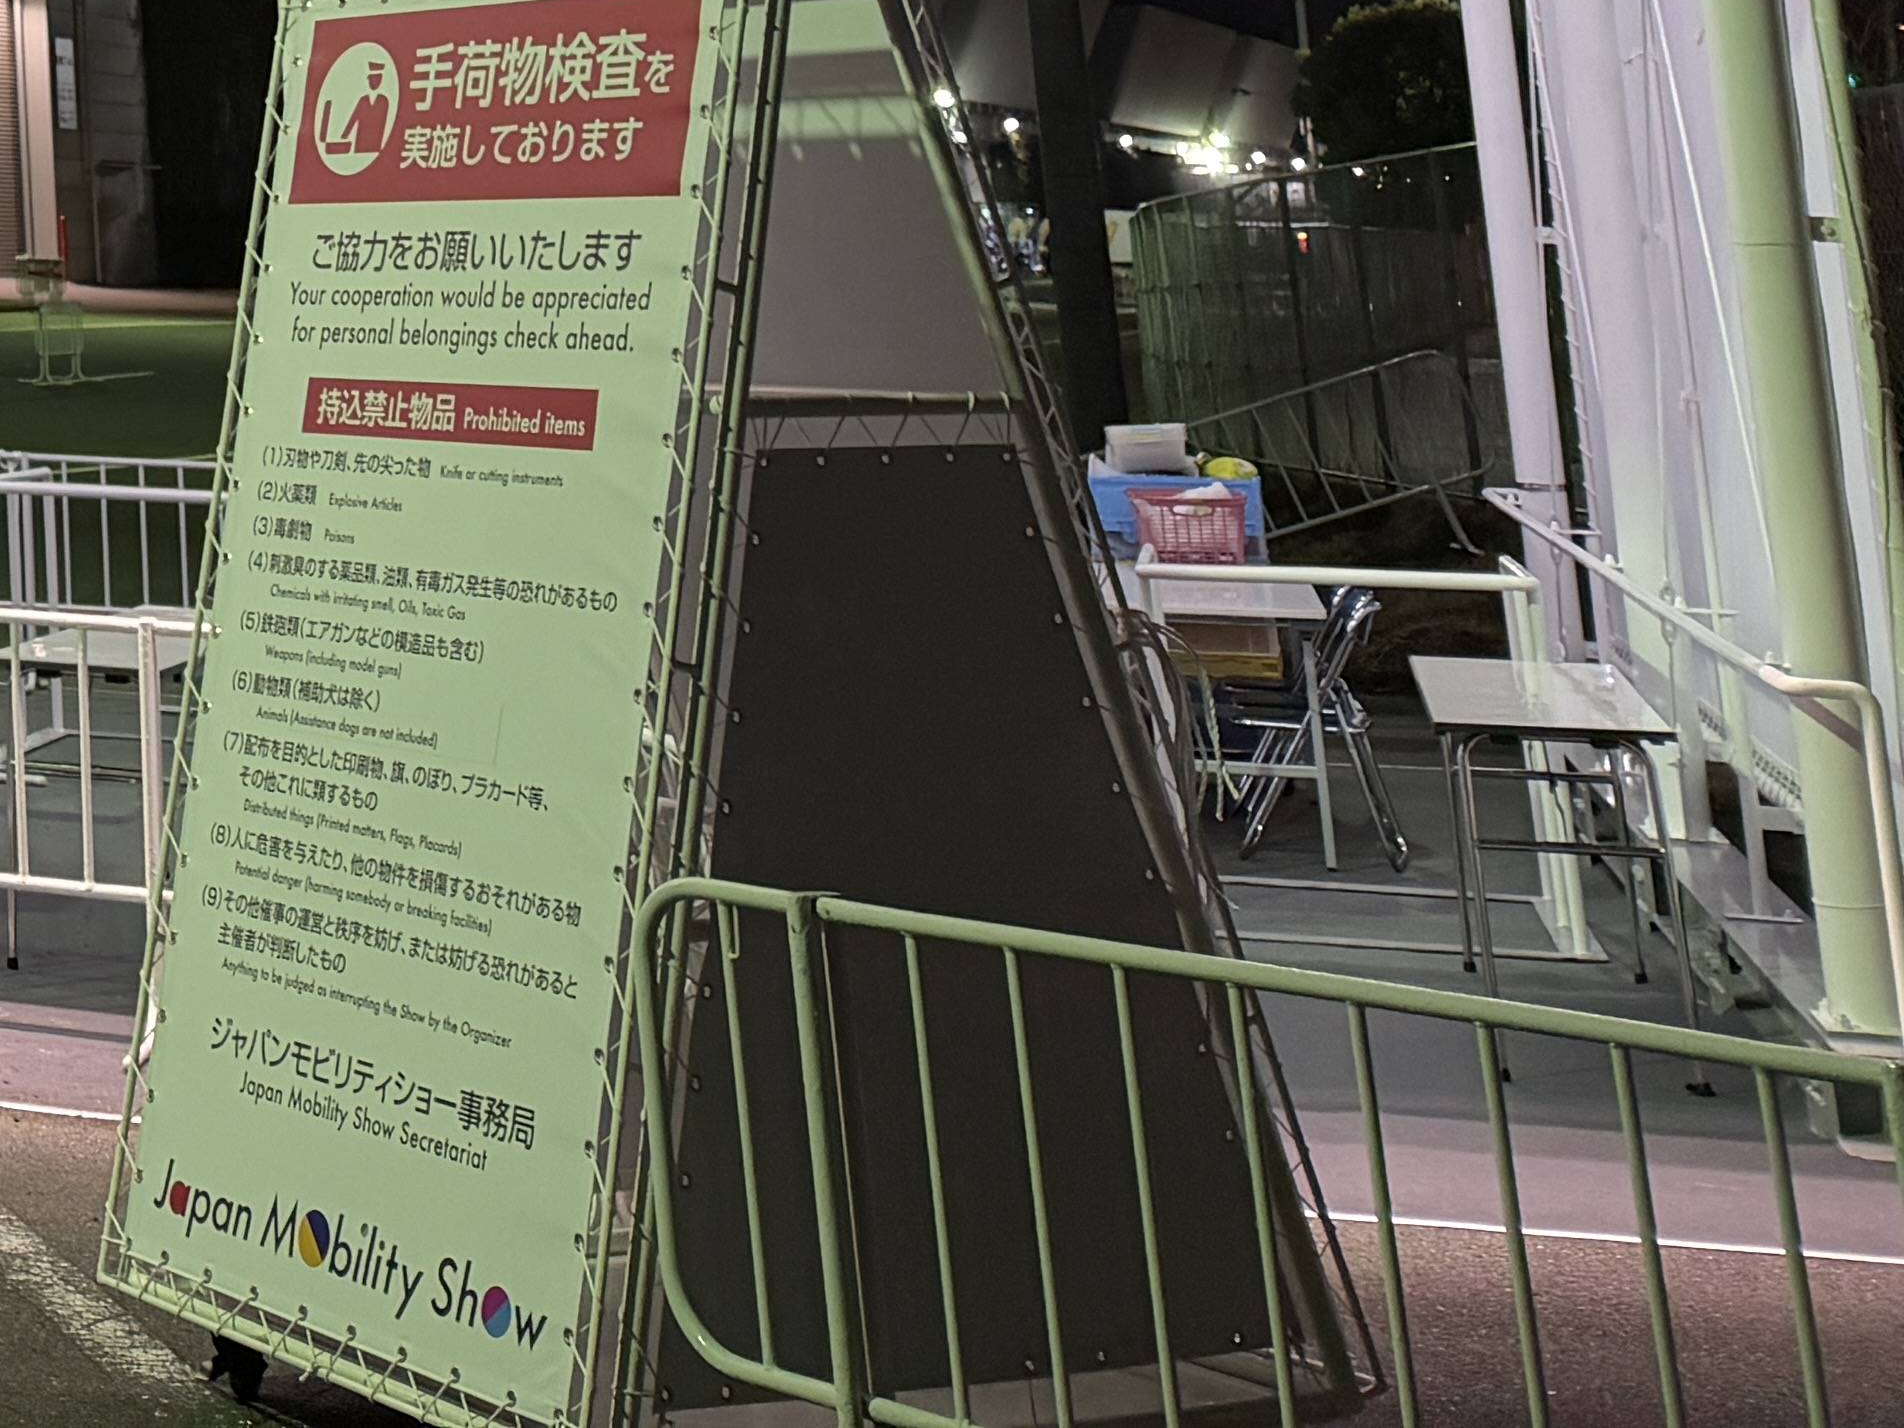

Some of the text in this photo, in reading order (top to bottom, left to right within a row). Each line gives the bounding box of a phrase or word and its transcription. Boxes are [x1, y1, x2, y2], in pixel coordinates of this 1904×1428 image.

[409, 28, 674, 111] 手荷物検査を
[399, 116, 644, 169] 実施しております
[312, 228, 643, 273] ご協力をお願いいたします
[290, 279, 653, 319] Your cooperation would be appreciated
[291, 314, 634, 356] for personal belongings check ahead.
[316, 387, 585, 436] 持込禁止物品 Prohibited items
[465, 470, 477, 481] or
[323, 528, 355, 545] Poisons
[446, 604, 466, 621] Gas
[264, 644, 304, 663] Weapons
[348, 656, 377, 673] model
[255, 705, 289, 724] Animals
[338, 717, 360, 738] dogs
[361, 726, 377, 738] are
[379, 728, 395, 740] not
[239, 765, 379, 812] その他これに類するもの
[289, 807, 315, 829] things
[271, 868, 303, 891] danger
[393, 901, 405, 913] or
[217, 921, 347, 974] 主催者が判断したもの
[260, 967, 270, 981] to
[271, 968, 283, 985] be
[317, 985, 327, 998] as
[382, 999, 397, 1017] the
[399, 1003, 426, 1023] Show
[427, 1010, 441, 1033] by
[442, 1015, 458, 1034] the
[460, 1020, 513, 1049] Organizer
[210, 1017, 536, 1151] ジャパンモビリティショー事務局
[239, 1070, 488, 1171] Japan Mobility Show Secretariat
[153, 1158, 253, 1241] Japan
